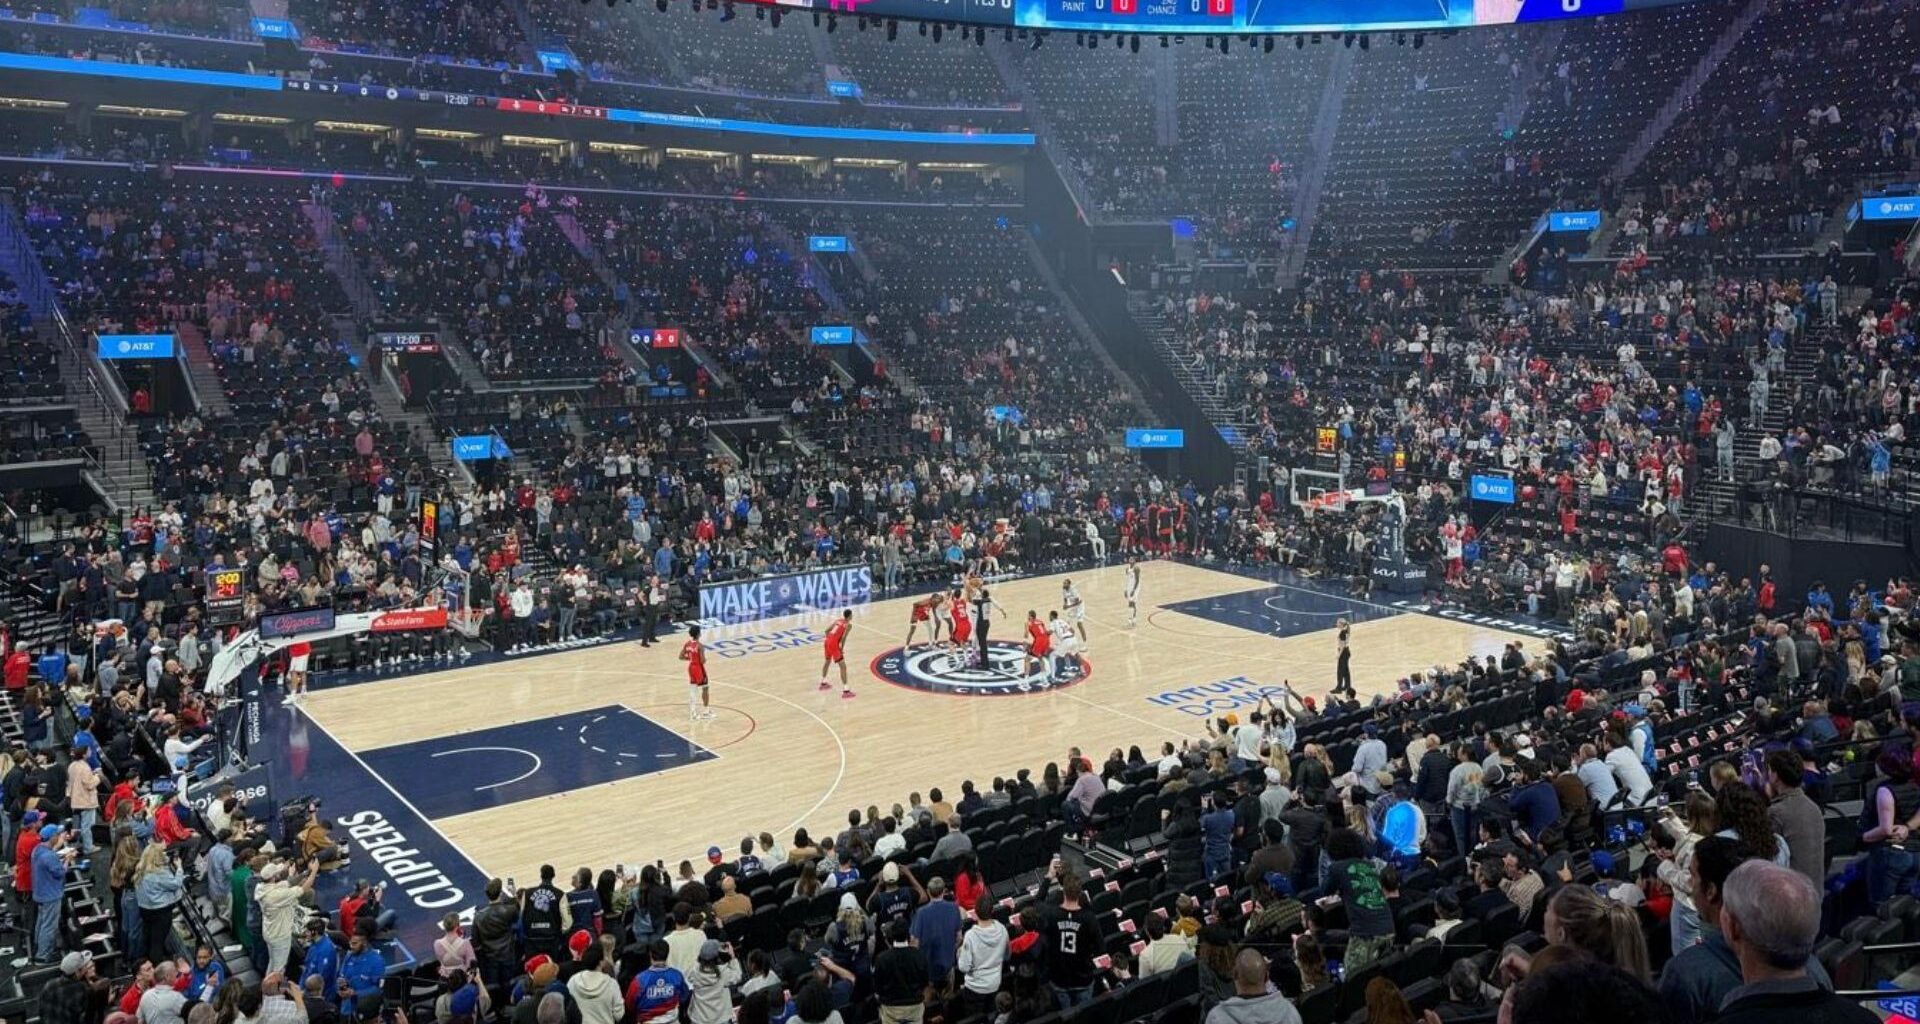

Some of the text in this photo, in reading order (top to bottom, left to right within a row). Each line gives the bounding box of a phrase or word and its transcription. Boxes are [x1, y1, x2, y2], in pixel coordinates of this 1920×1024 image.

[1063, 2, 1085, 12] PAINT
[1147, 5, 1177, 15] CHANCE
[445, 95, 469, 105] 12:00
[1893, 203, 1915, 211] AT&T
[397, 335, 420, 345] 12:00
[131, 342, 155, 351] AT&T
[1489, 486, 1508, 494] AT&T
[217, 585, 235, 597] 24
[700, 566, 872, 619] MAKE WAVES
[274, 616, 322, 633] Clippers
[702, 626, 812, 651] INTUIT
[1146, 676, 1258, 706] INTUIT
[252, 701, 260, 743] PECHANGA
[337, 810, 464, 909] CLIPPERS
[1061, 931, 1077, 954] 13
